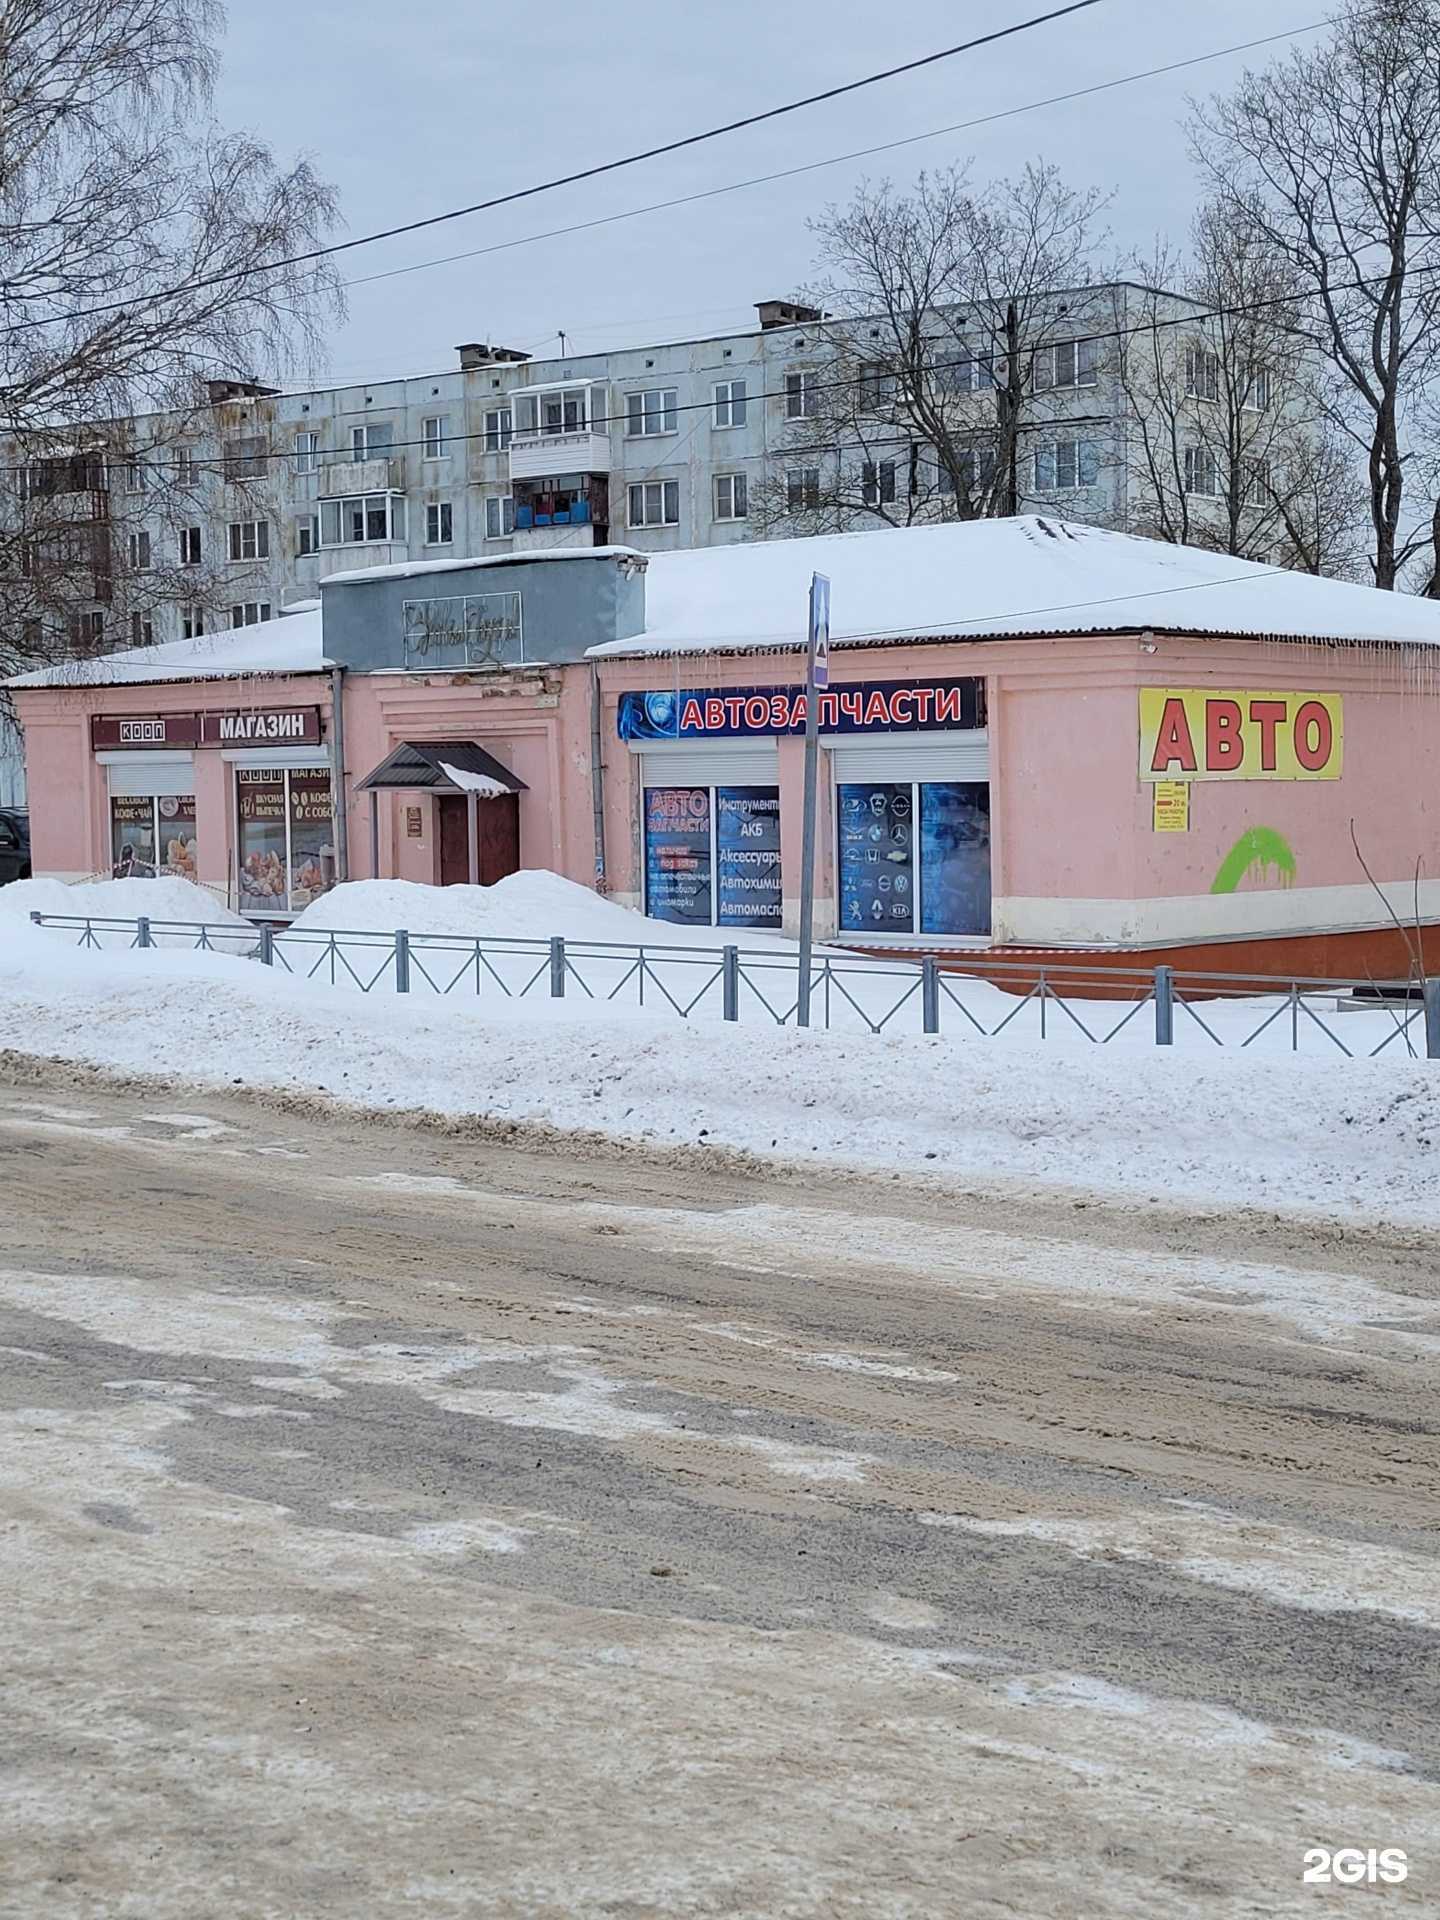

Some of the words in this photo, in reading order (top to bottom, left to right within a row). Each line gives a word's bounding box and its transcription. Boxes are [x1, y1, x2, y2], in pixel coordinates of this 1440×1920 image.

[680, 688, 962, 730] АВТОЗАПЧАСТИ
[120, 721, 166, 742] КООП
[219, 714, 305, 739] МАГАЗИН
[1150, 697, 1333, 772] АВТО
[649, 790, 709, 818] АВТО
[718, 797, 779, 813] Инструмент
[740, 823, 764, 837] АКБ
[719, 876, 783, 889] Автохими
